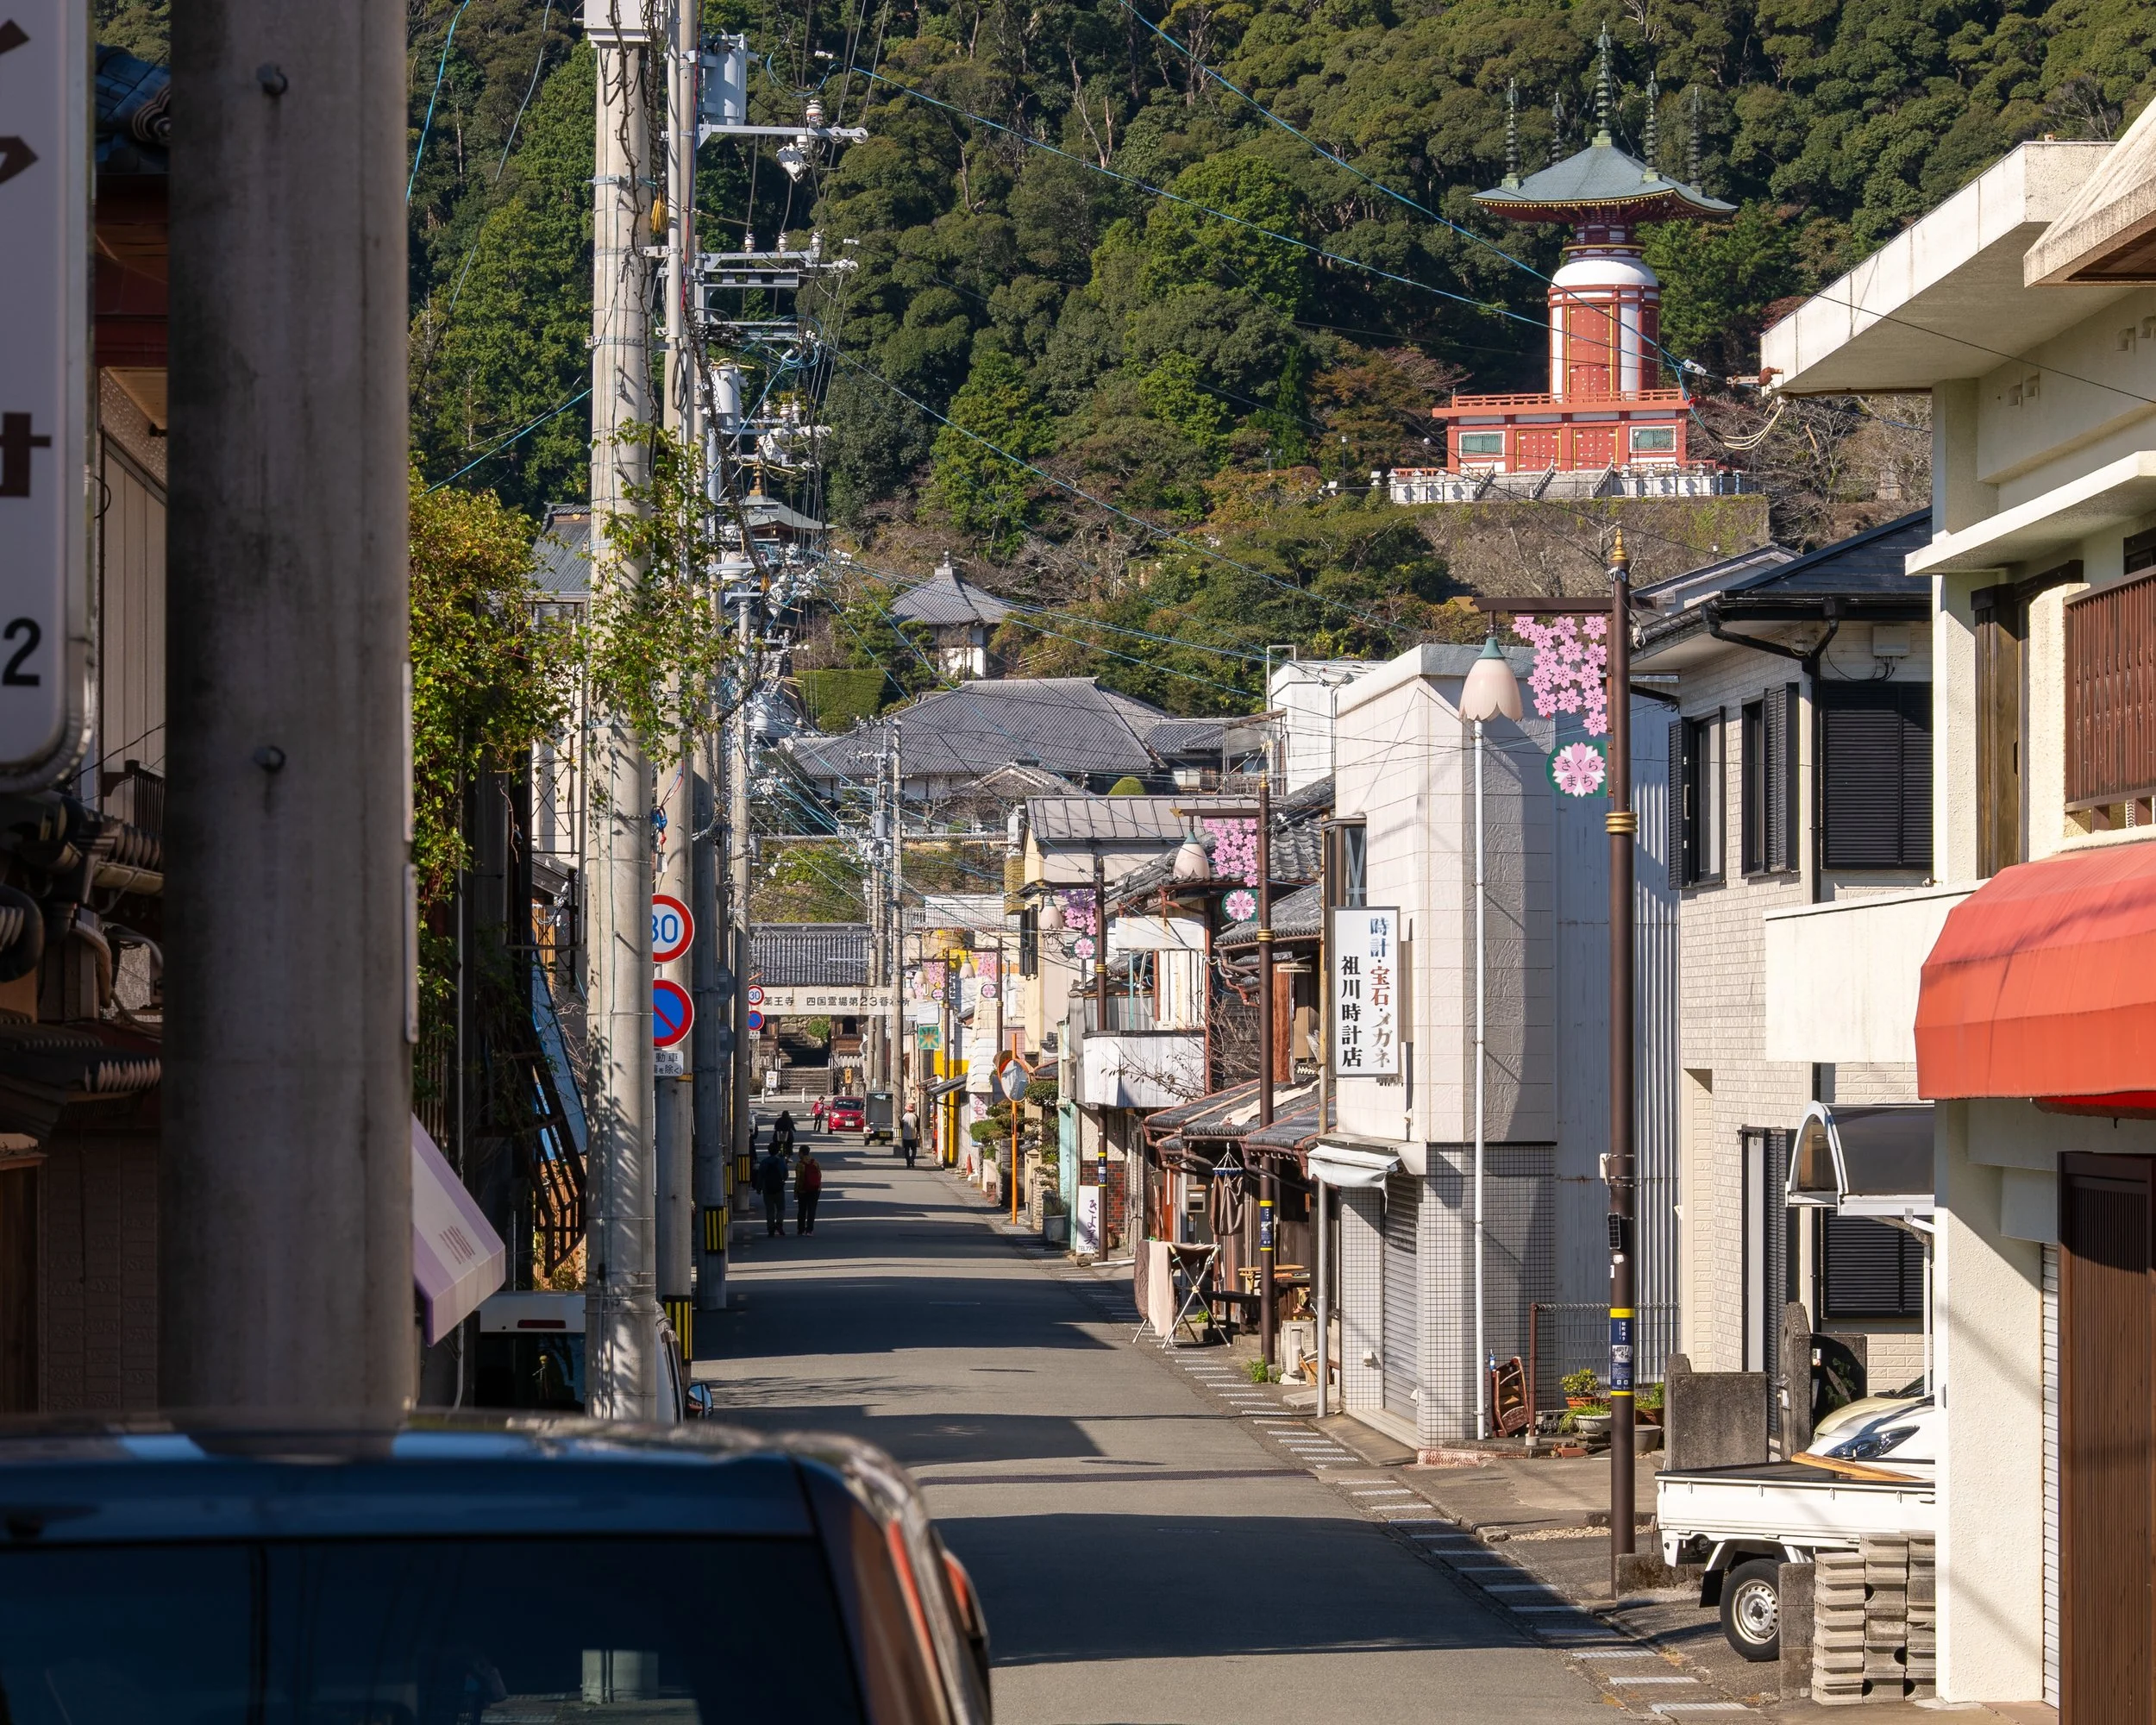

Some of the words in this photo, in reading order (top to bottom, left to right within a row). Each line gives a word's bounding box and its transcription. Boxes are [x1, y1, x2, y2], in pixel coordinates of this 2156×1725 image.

[1562, 759, 1598, 771] さくら
[1566, 775, 1593, 787] まち
[749, 990, 760, 1000] 30
[1341, 956, 1363, 1067] 祖川時計店
